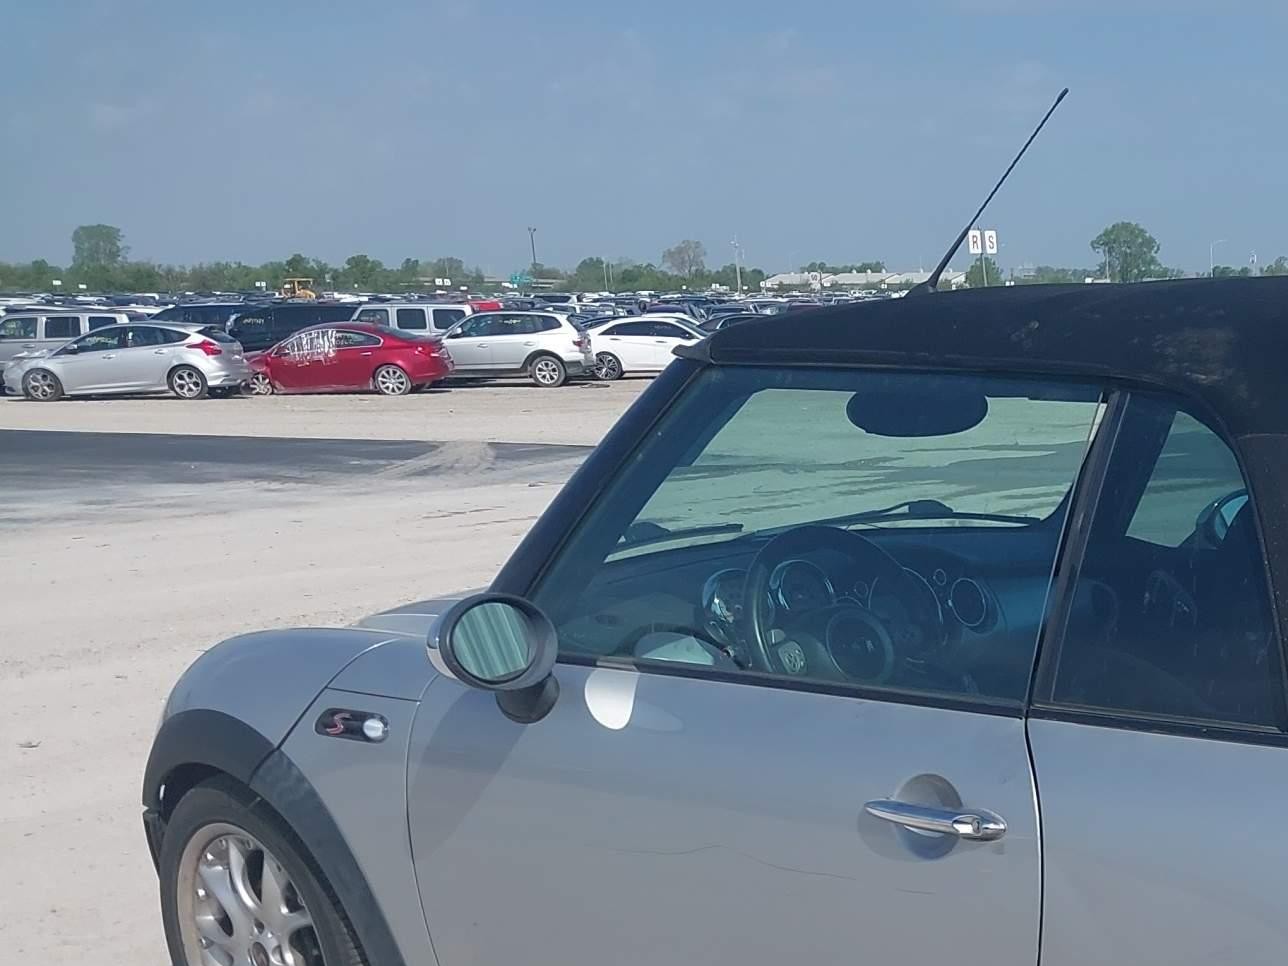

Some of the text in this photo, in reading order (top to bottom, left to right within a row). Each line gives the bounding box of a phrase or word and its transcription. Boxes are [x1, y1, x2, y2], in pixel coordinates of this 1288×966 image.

[971, 234, 980, 250] R
[988, 234, 995, 250] S
[325, 712, 353, 736] S
